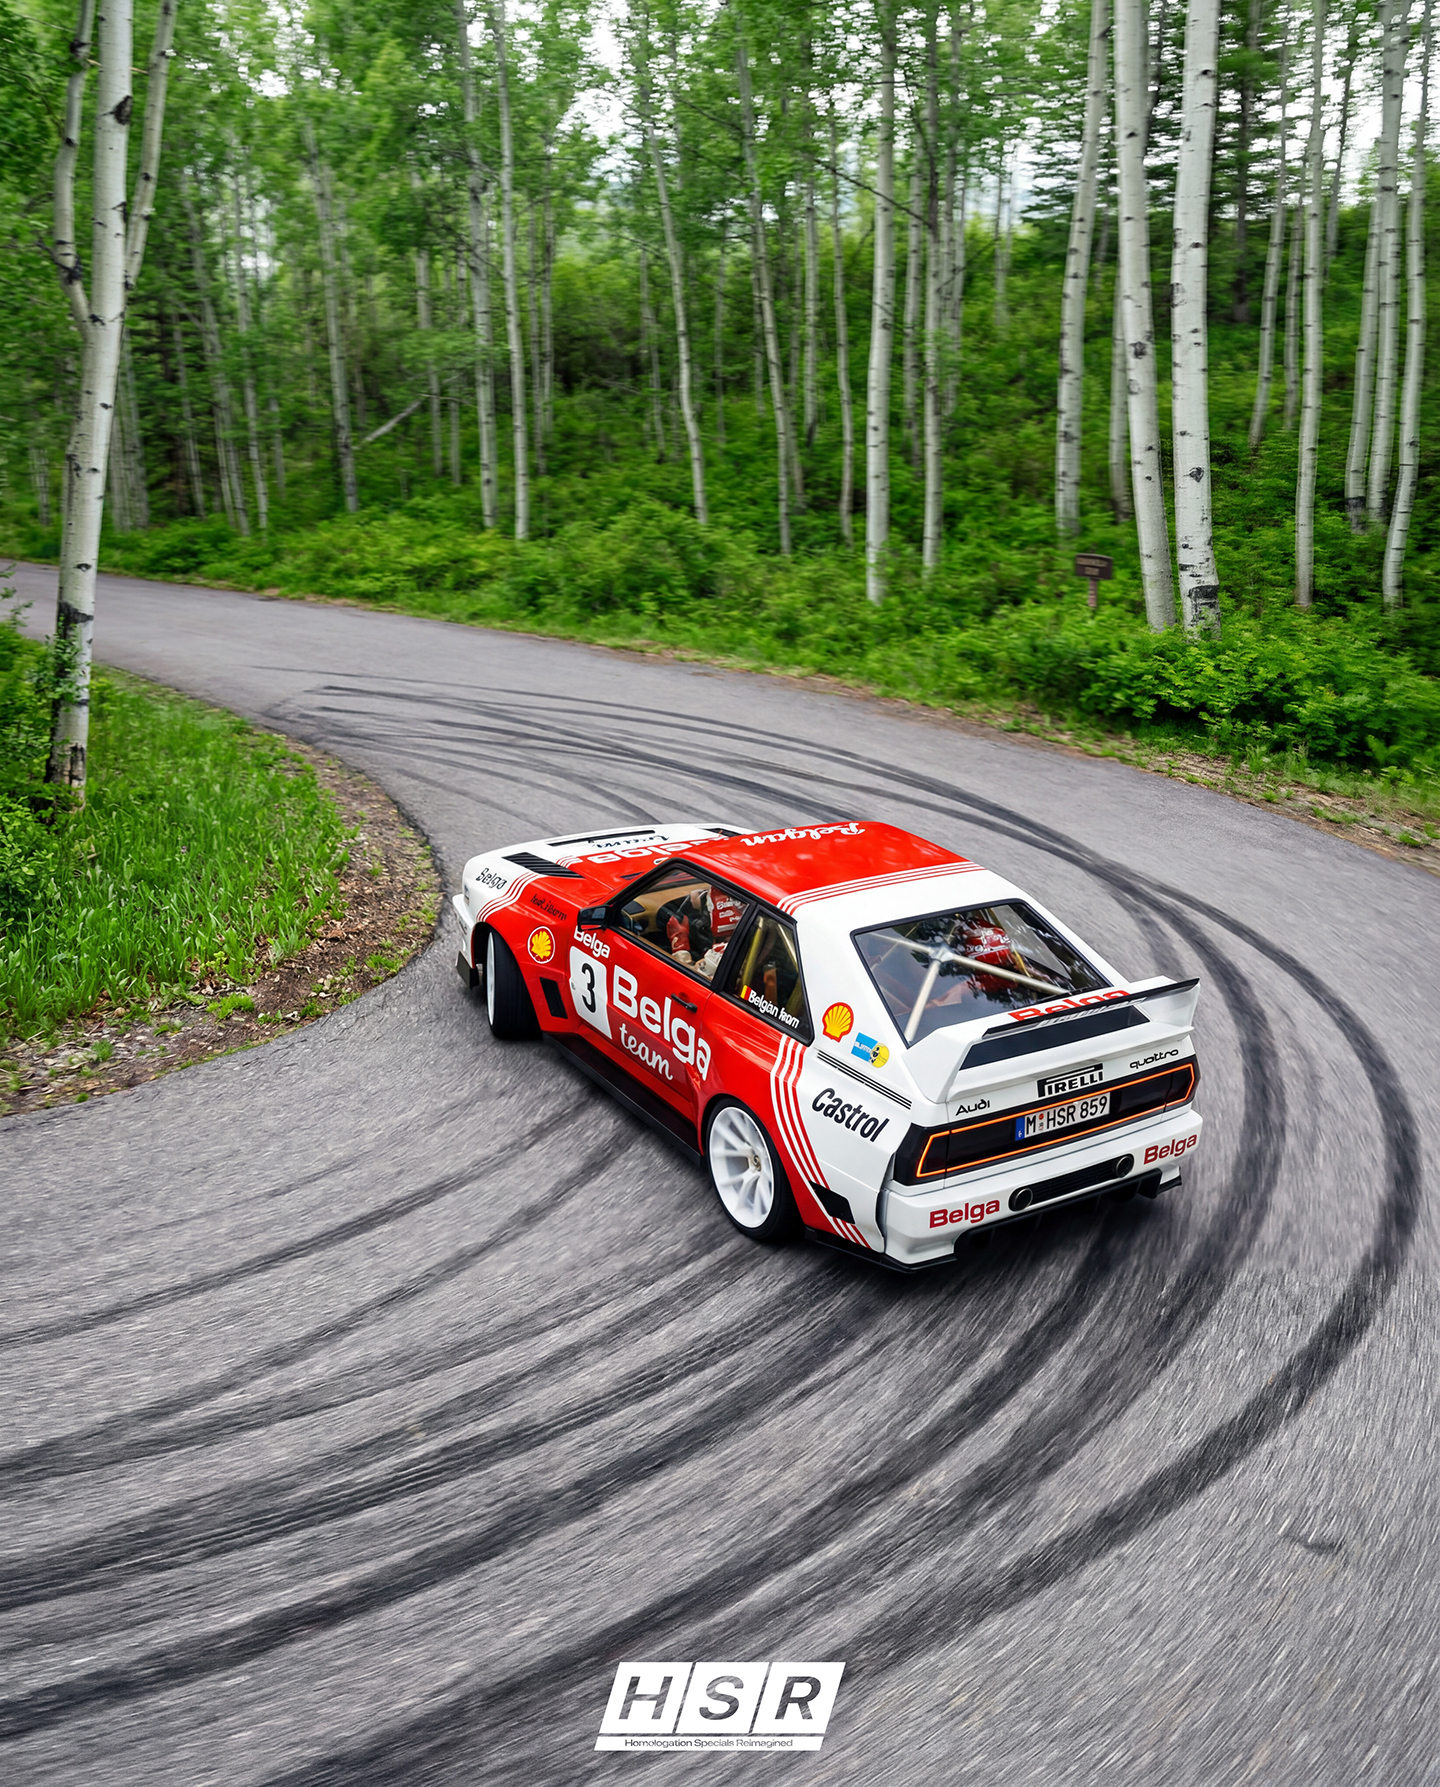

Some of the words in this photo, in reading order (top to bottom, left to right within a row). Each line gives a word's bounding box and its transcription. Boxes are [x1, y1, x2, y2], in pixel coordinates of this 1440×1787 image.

[475, 867, 508, 890] Belga
[581, 962, 597, 1014] 3
[612, 964, 712, 1082] Belga
[618, 1023, 674, 1081] team
[1129, 1048, 1180, 1070] quattro
[1036, 1062, 1104, 1098] PIRELLI
[811, 1087, 891, 1143] Castrol
[955, 1098, 991, 1117] Audi
[1026, 1114, 1037, 1135] M
[1046, 1104, 1077, 1130] HSR
[1080, 1095, 1108, 1119] 859
[1143, 1133, 1198, 1166] Belga
[929, 1199, 1000, 1229] Belga
